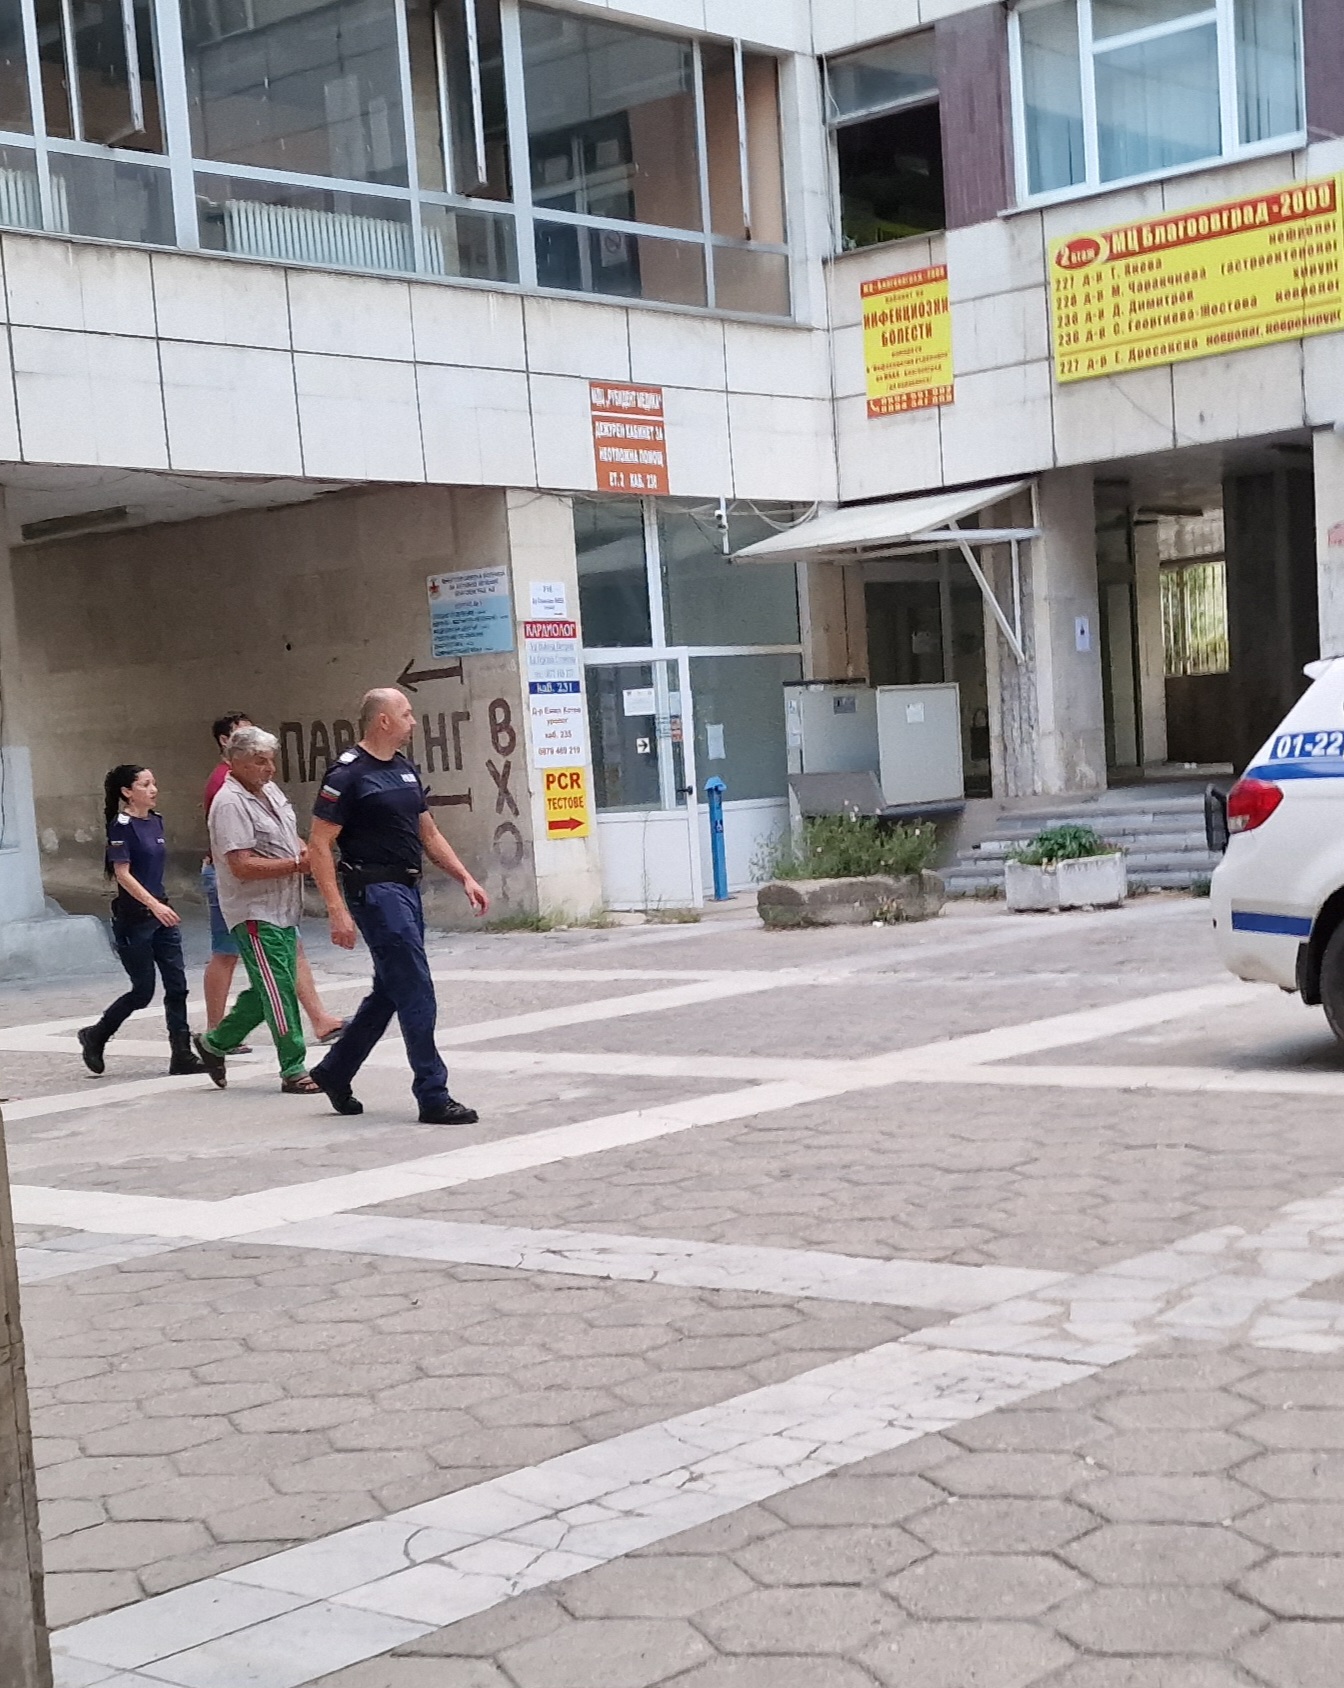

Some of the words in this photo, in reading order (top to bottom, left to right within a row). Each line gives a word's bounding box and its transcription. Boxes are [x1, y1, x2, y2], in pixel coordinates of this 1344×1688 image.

[1111, 230, 1139, 254] МЦ
[864, 297, 949, 330] ИНФЕКЦИОЗНИ
[881, 322, 933, 347] БОЛЕСТИ
[280, 711, 470, 783] ПАРНГ
[1276, 731, 1344, 759] 01-22
[546, 772, 582, 790] PCR
[547, 796, 584, 810] ТЕСТОВЕ
